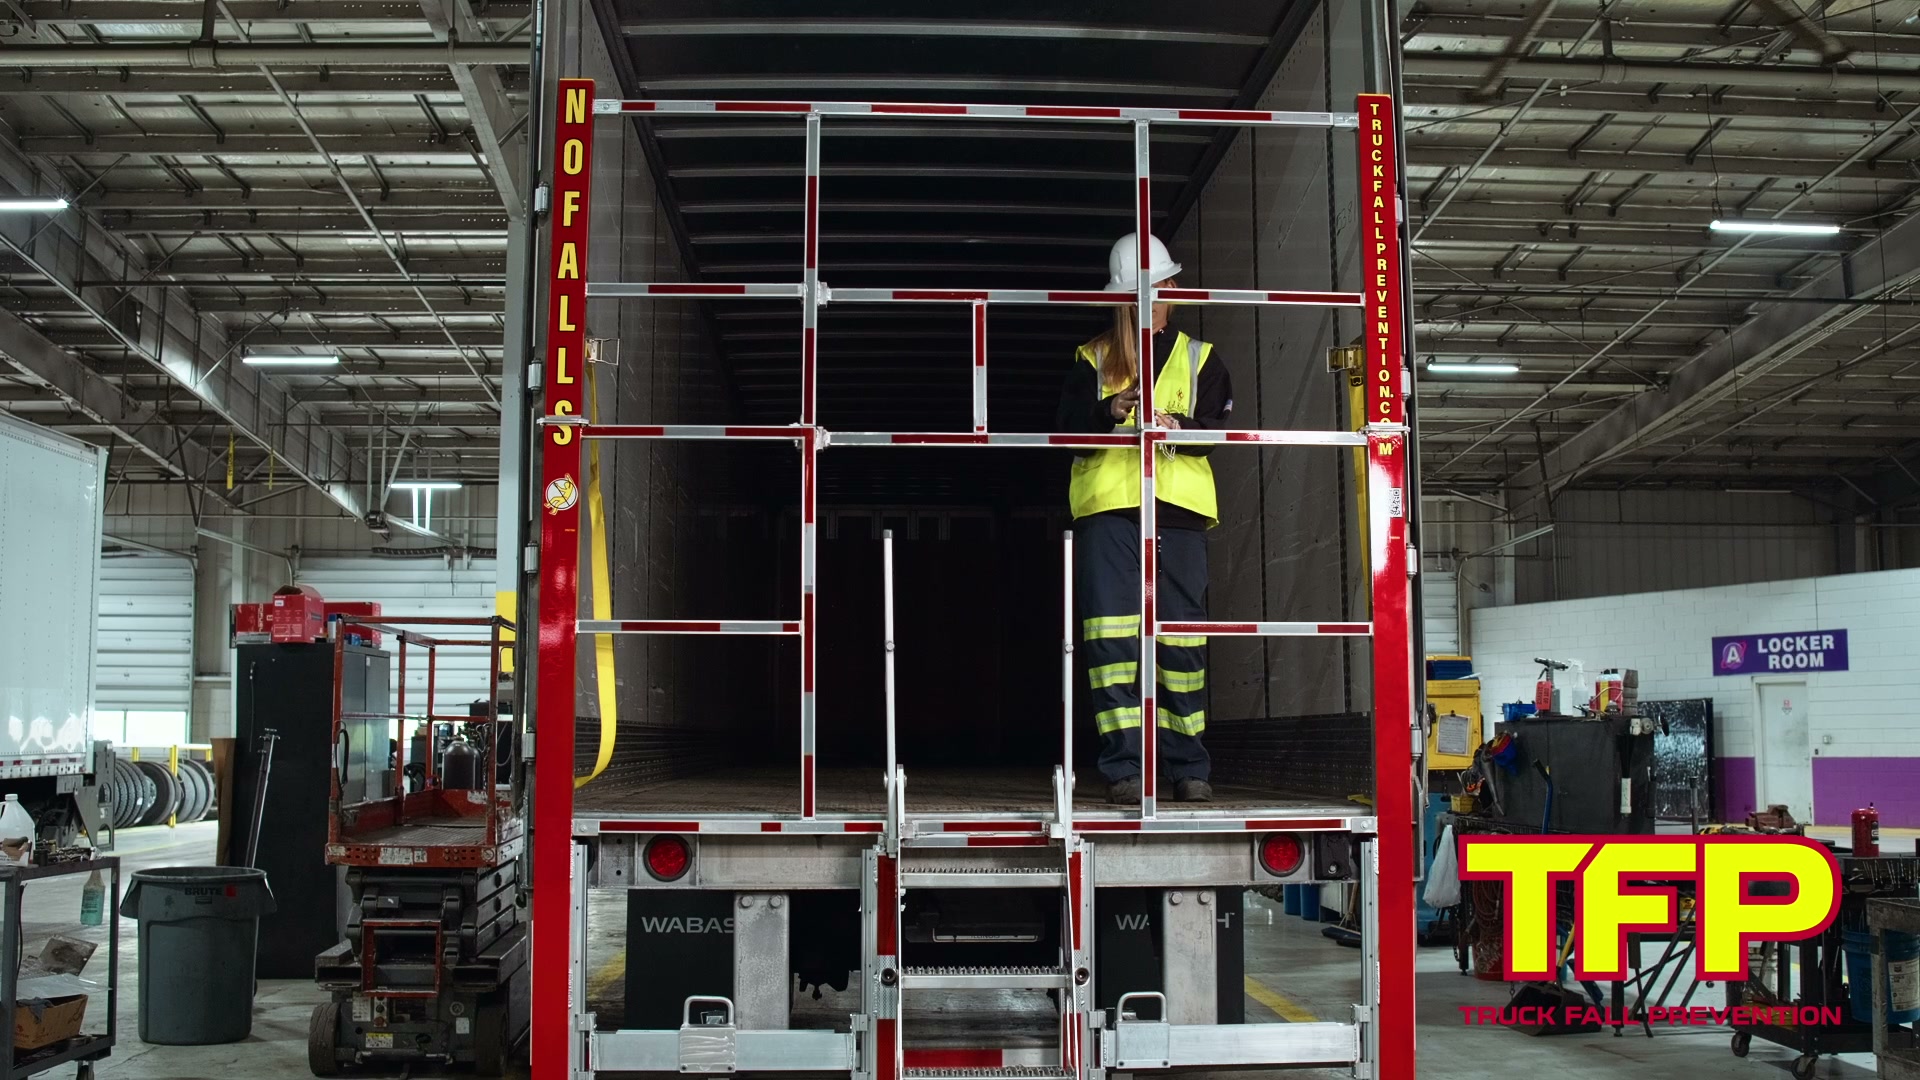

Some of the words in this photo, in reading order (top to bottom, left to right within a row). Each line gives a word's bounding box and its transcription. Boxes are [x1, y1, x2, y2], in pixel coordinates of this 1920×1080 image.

[1757, 634, 1835, 654] LOCKER
[1726, 645, 1741, 663] A
[1768, 652, 1825, 670] ROOM
[185, 887, 223, 896] BRUTE
[641, 916, 735, 934] WABAS
